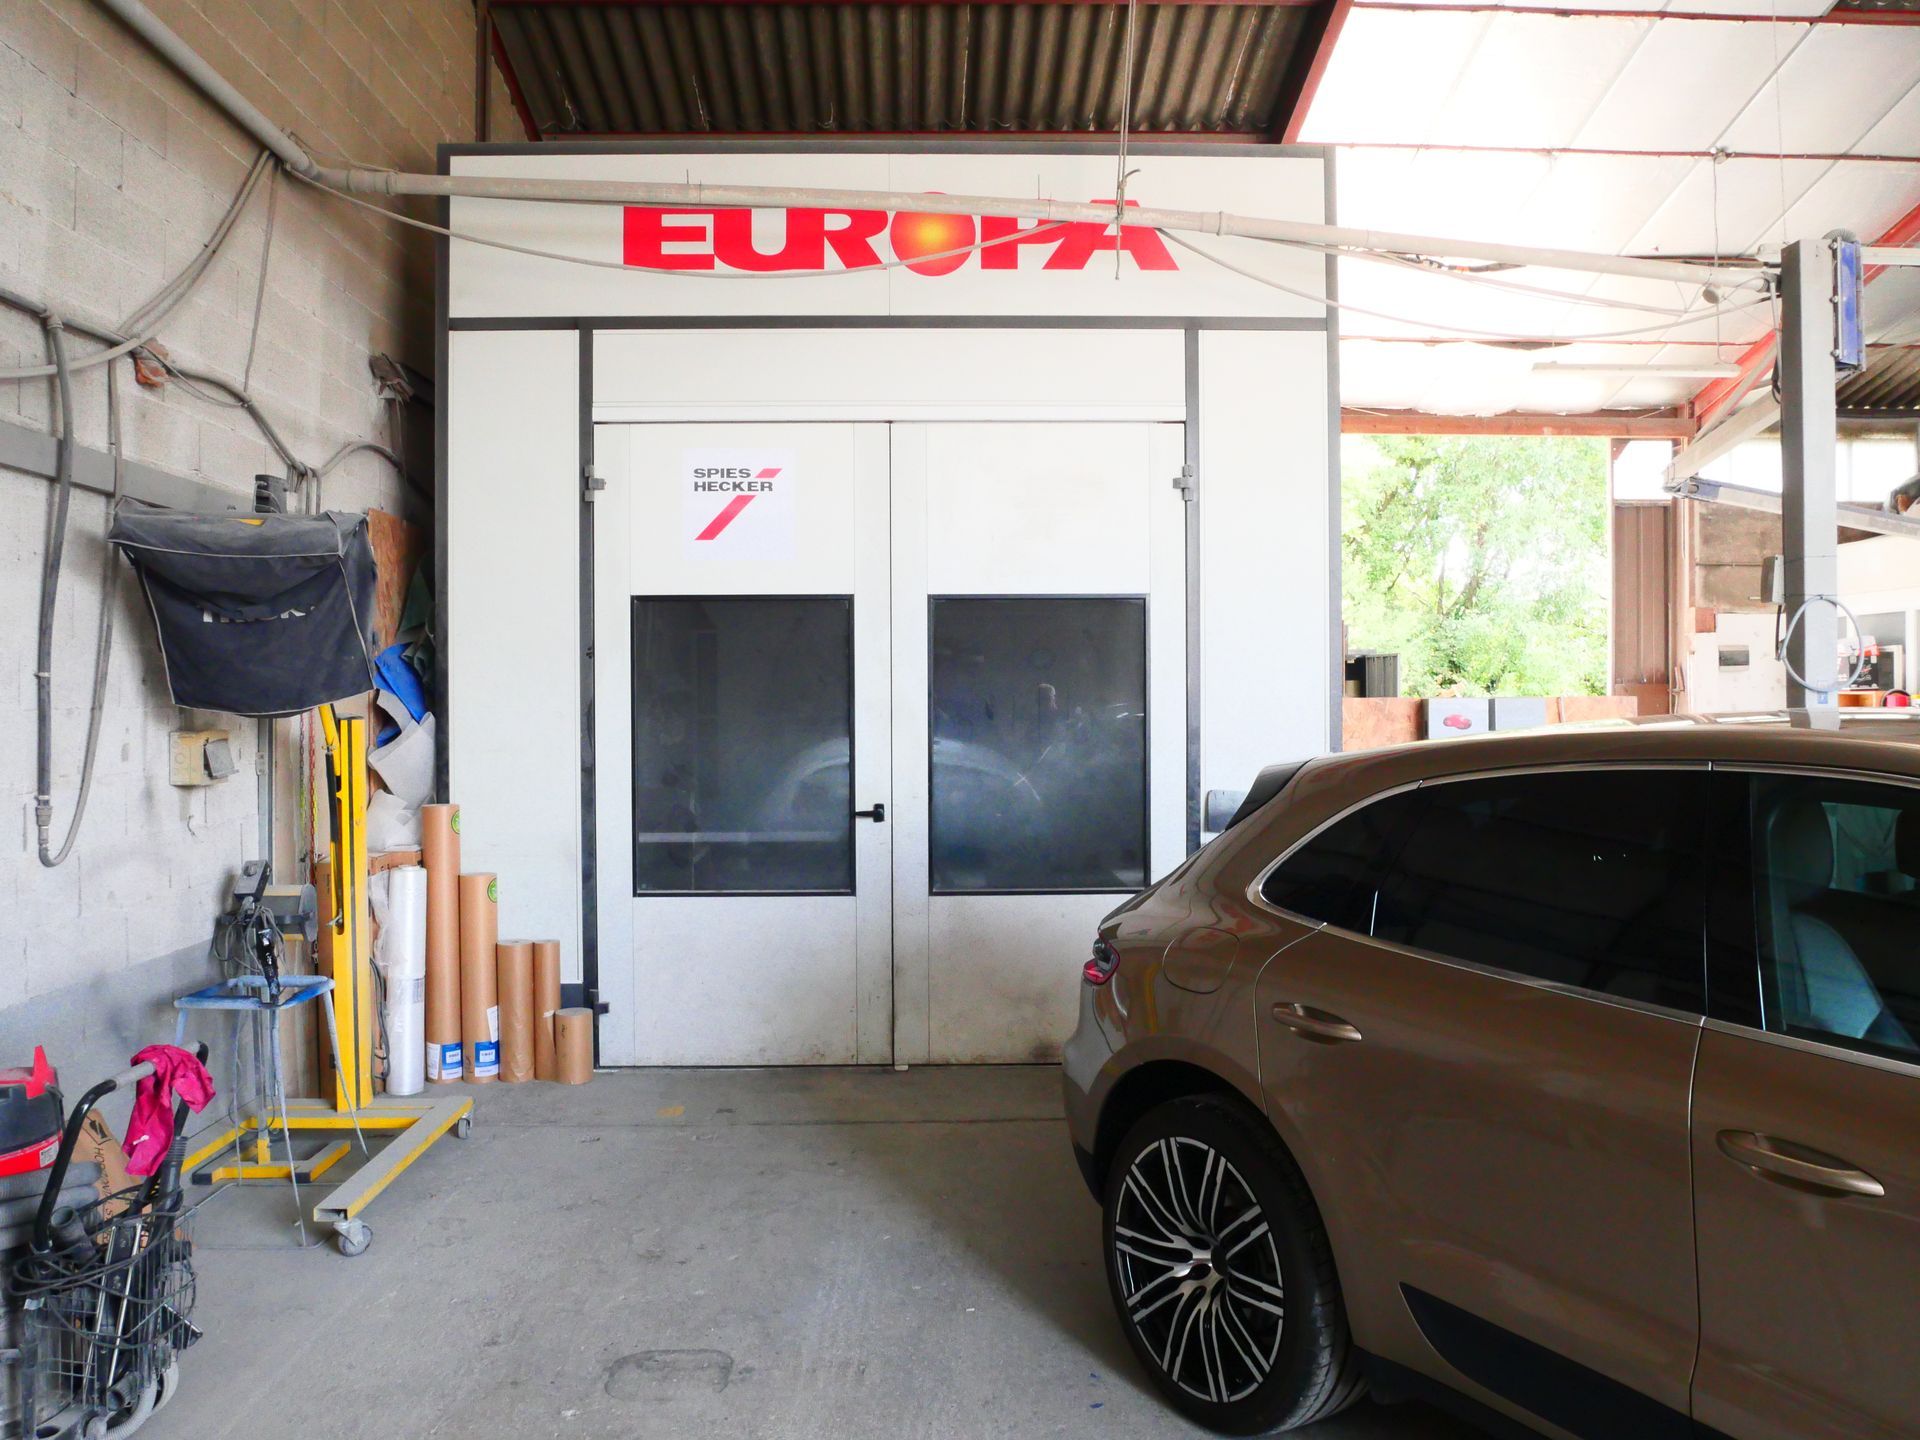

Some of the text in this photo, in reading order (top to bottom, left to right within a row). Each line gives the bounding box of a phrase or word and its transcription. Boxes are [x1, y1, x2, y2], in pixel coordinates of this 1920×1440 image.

[623, 191, 1180, 277] EUROPA
[693, 467, 752, 479] SPIES
[693, 481, 774, 492] HECKER
